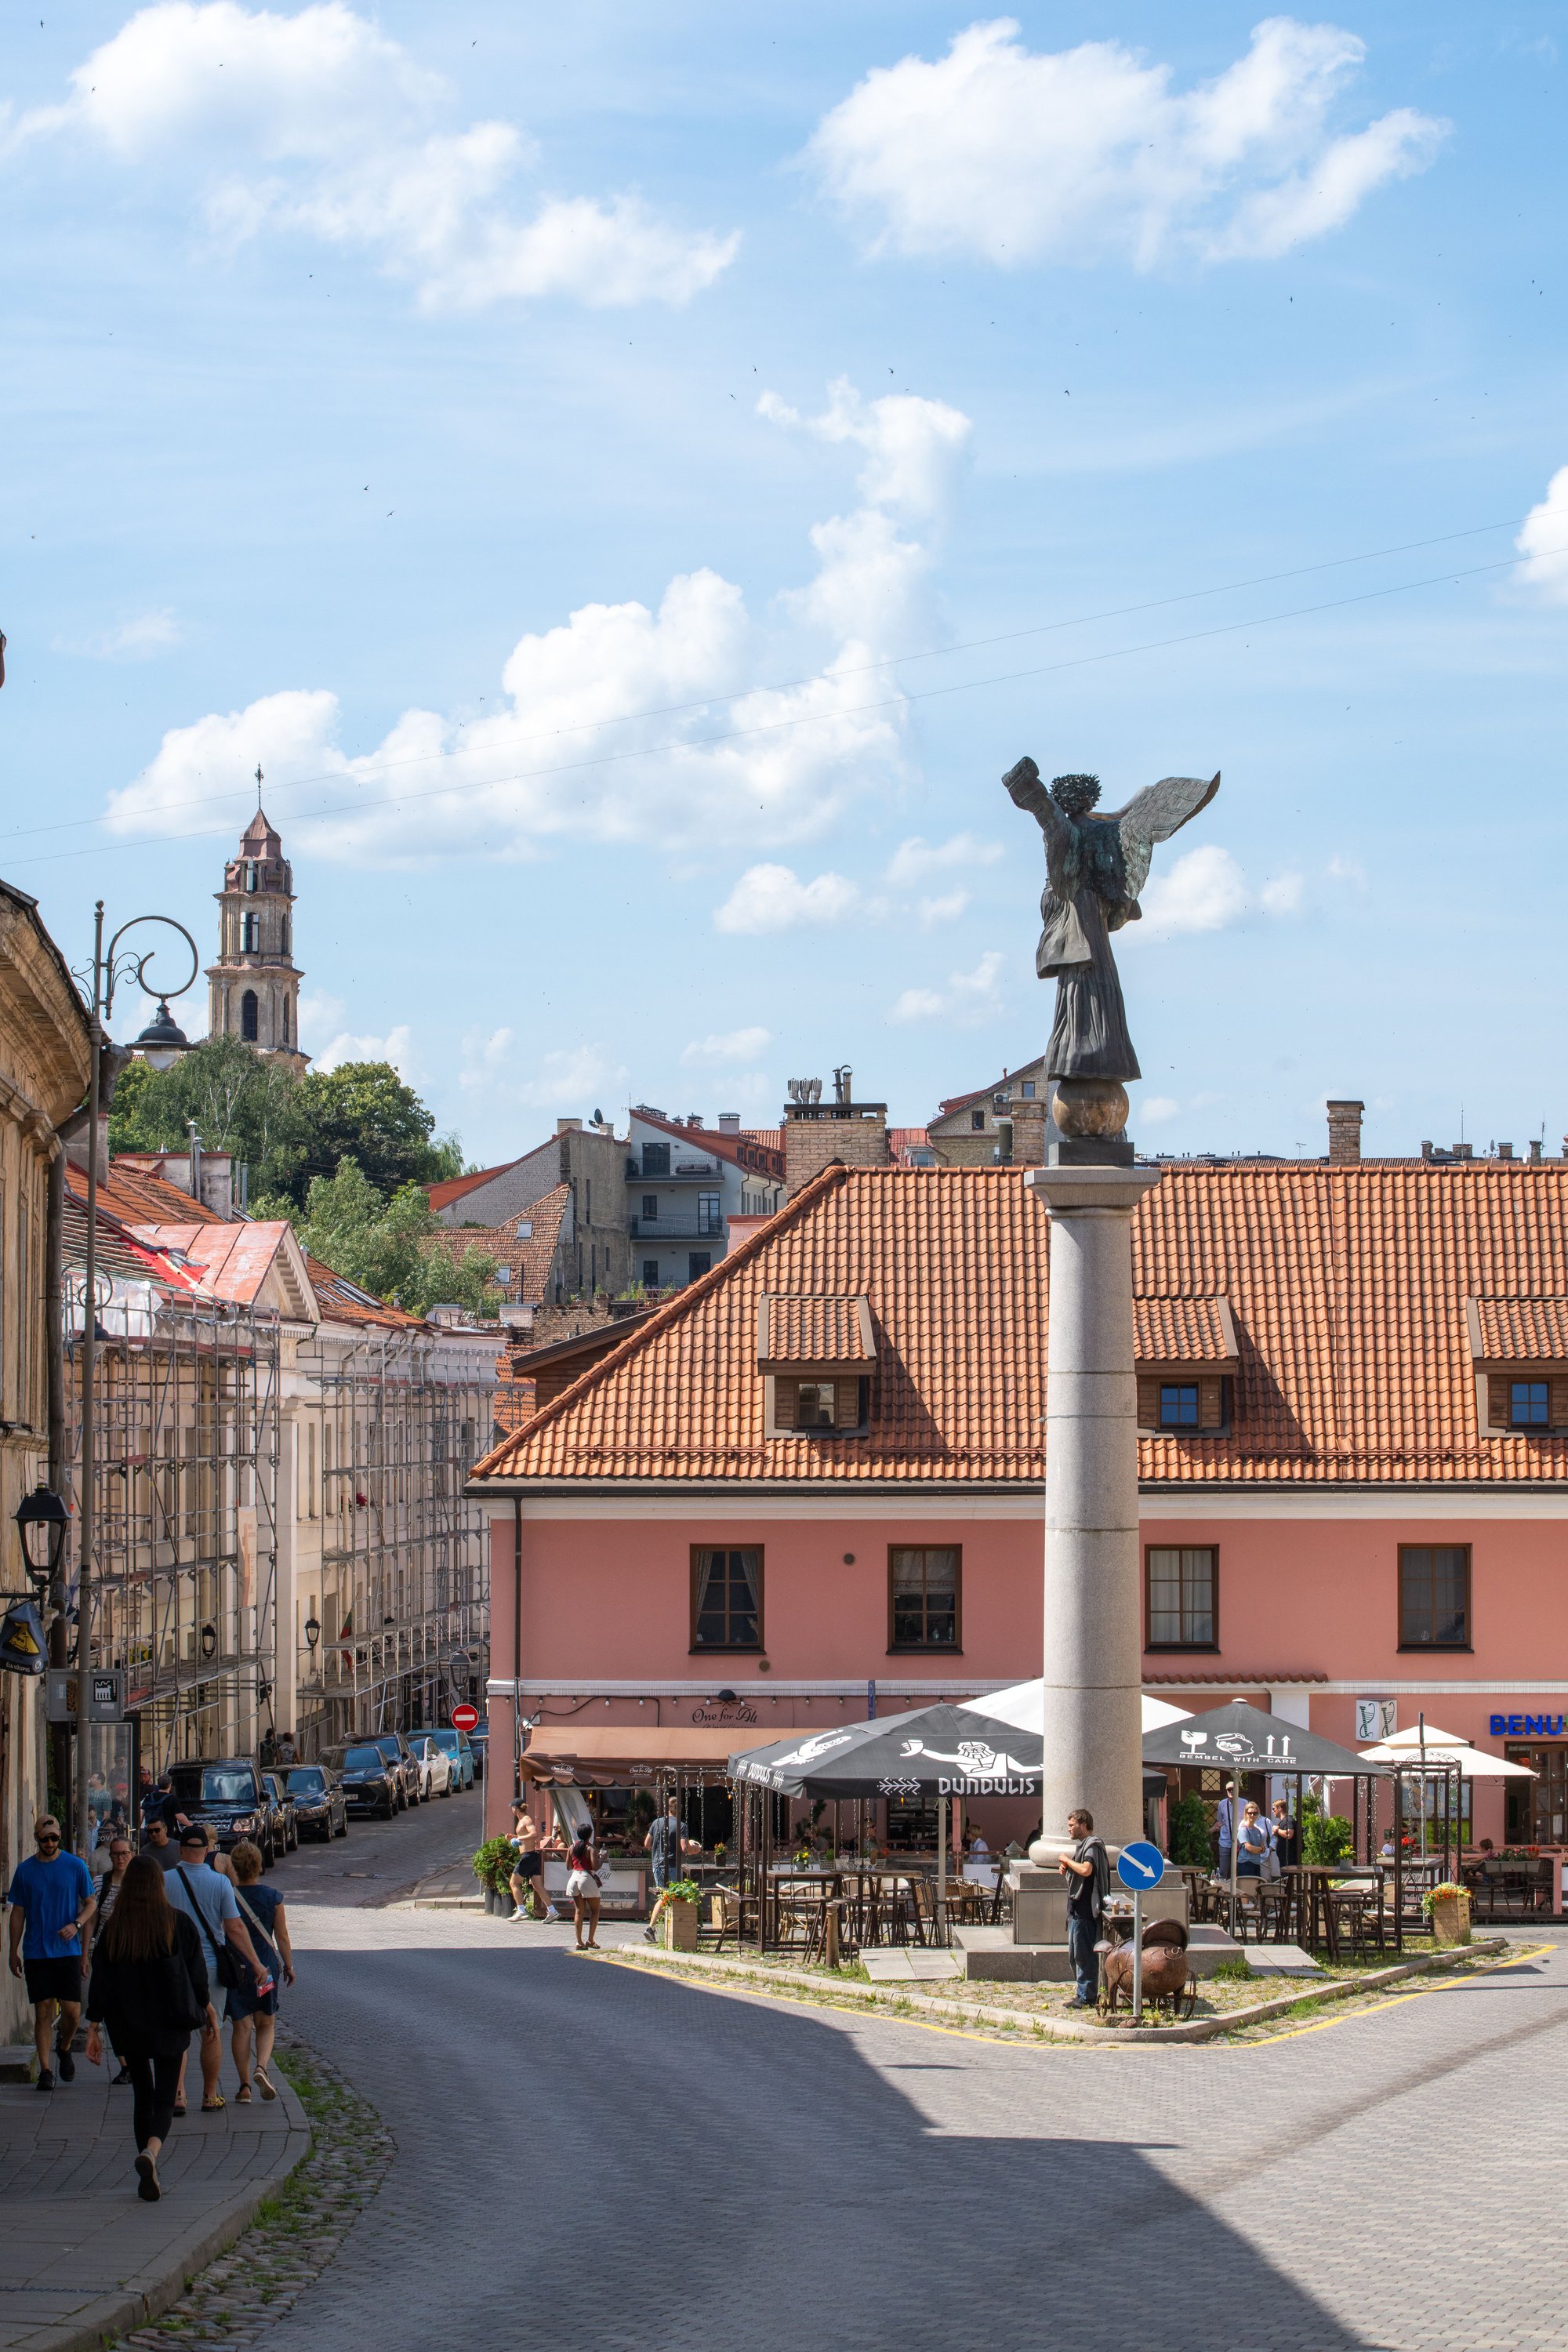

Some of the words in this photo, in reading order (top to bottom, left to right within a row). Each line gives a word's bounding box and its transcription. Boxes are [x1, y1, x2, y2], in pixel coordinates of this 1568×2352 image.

[692, 1708, 717, 1723] One
[719, 1708, 734, 1722] for
[735, 1707, 758, 1723] All
[1490, 1715, 1563, 1736] BENU
[938, 1777, 1035, 1795] DUNDULIS
